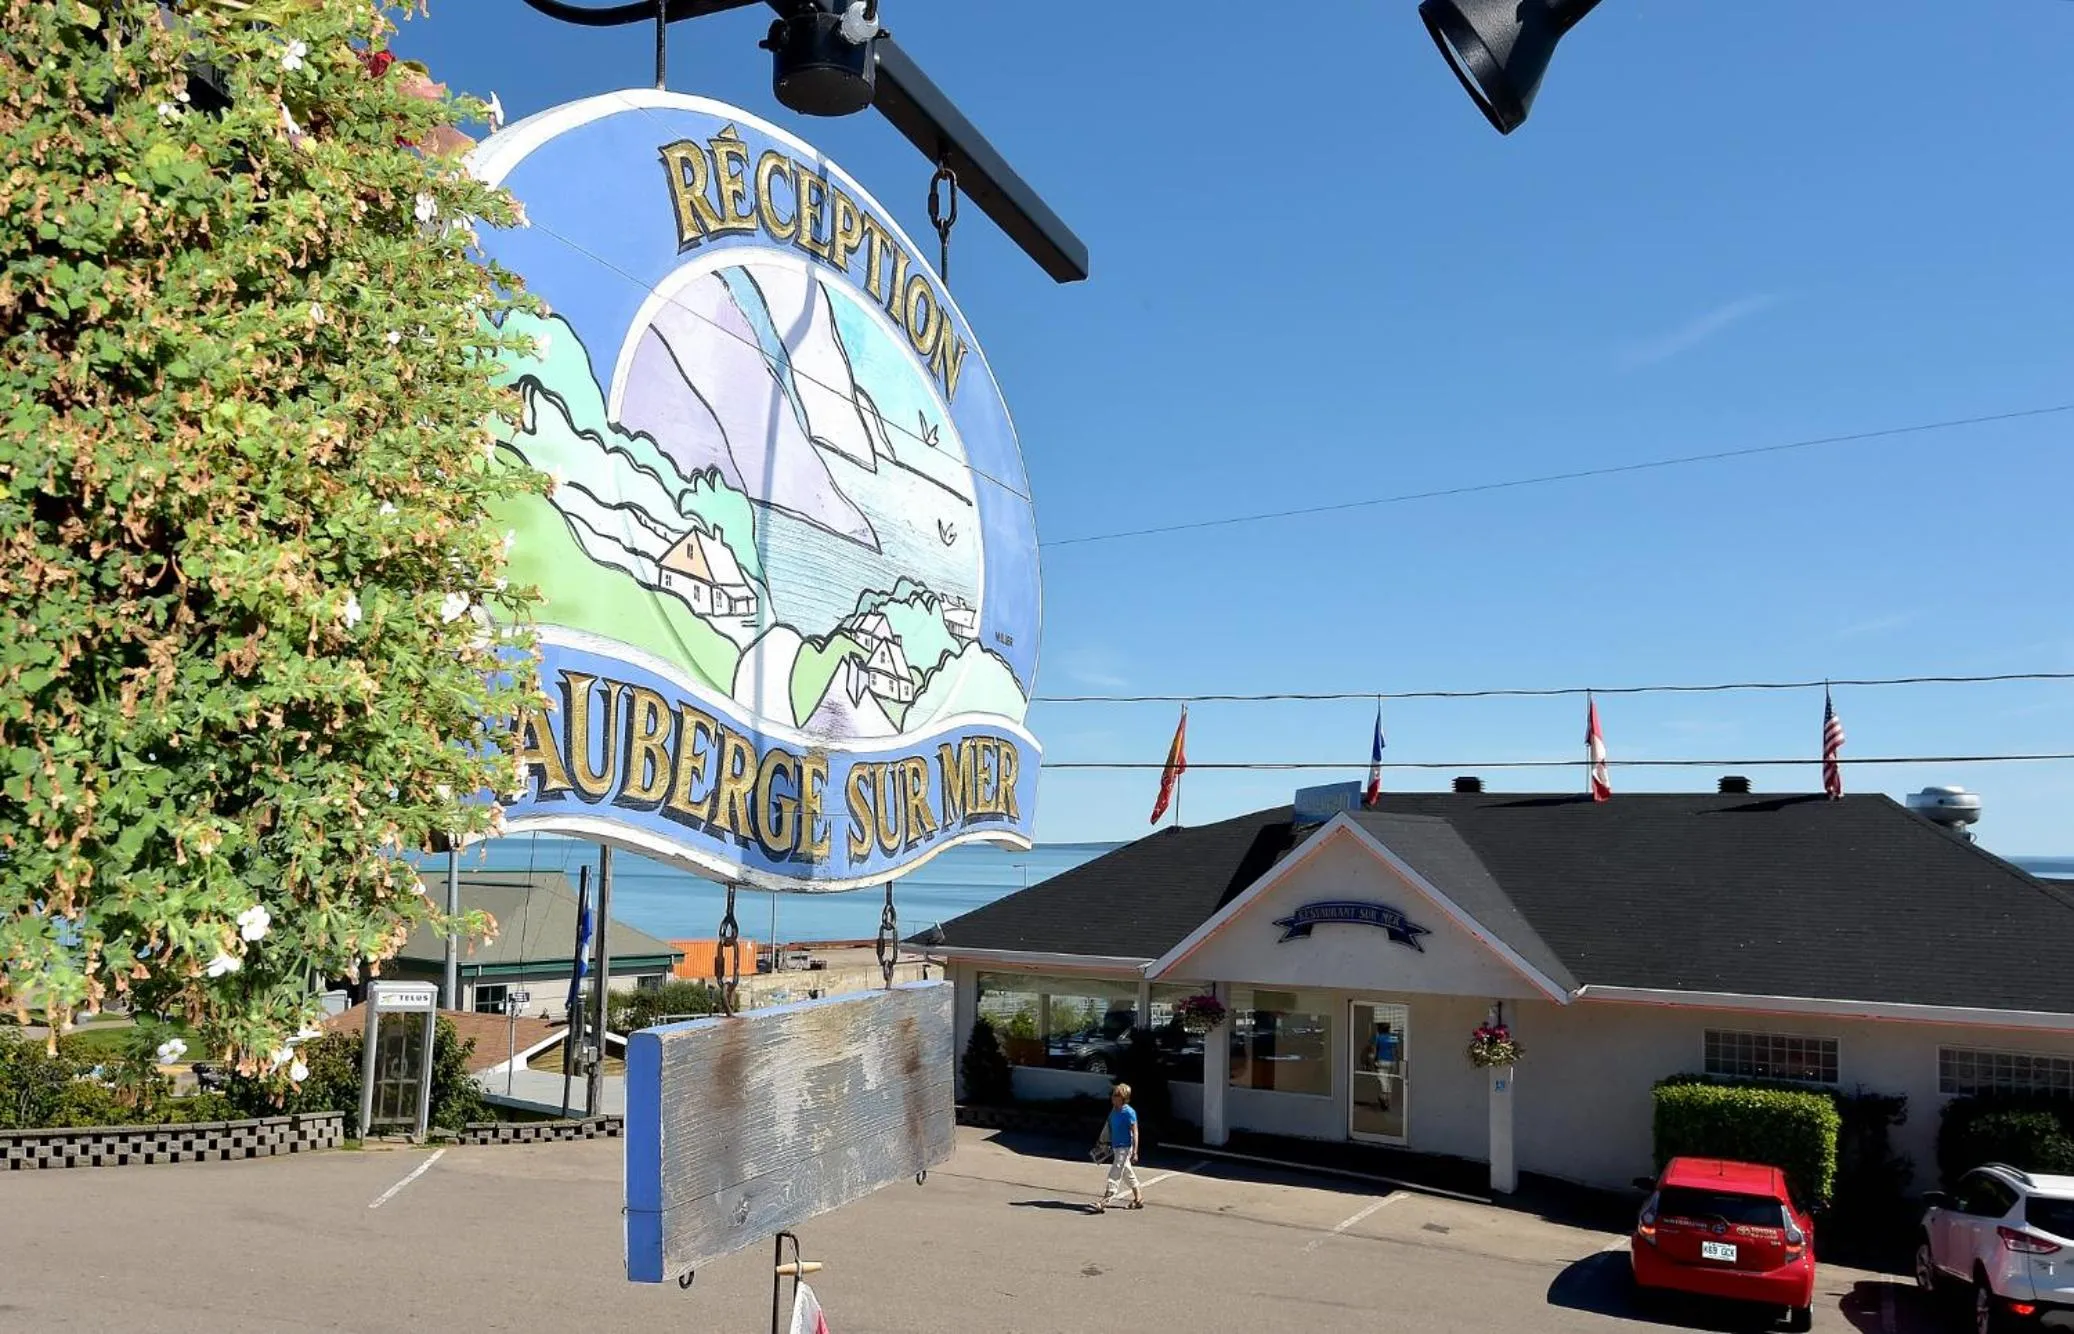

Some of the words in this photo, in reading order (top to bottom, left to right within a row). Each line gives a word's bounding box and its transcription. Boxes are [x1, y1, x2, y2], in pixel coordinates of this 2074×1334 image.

[658, 123, 968, 401] RÉCEPTION
[502, 669, 831, 864] AUBERGE
[846, 755, 938, 864] SUR
[937, 736, 1020, 832] MER
